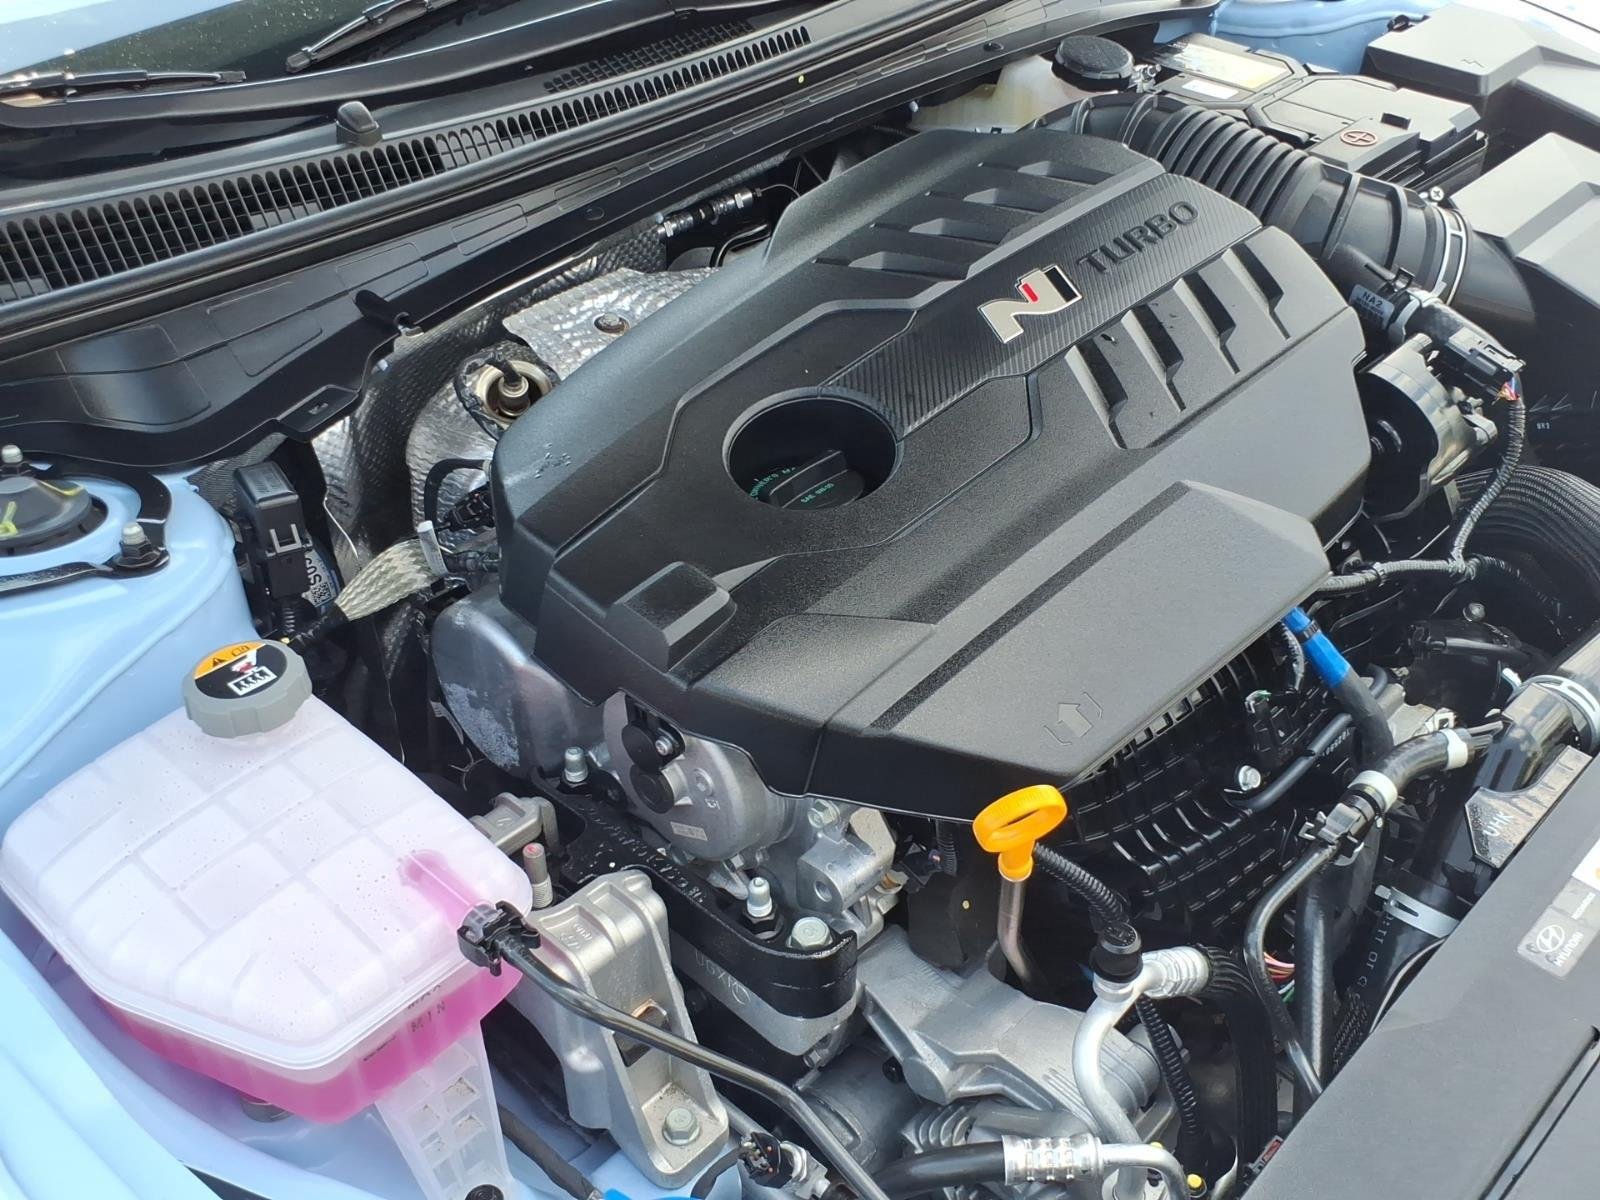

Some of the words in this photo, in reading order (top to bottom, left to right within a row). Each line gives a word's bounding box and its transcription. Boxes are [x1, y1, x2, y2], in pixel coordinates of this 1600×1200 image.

[1076, 201, 1200, 274] TURBO
[1362, 291, 1384, 309] NA2
[1553, 931, 1585, 967] HYUNDAI
[411, 1000, 446, 1032] MIN
